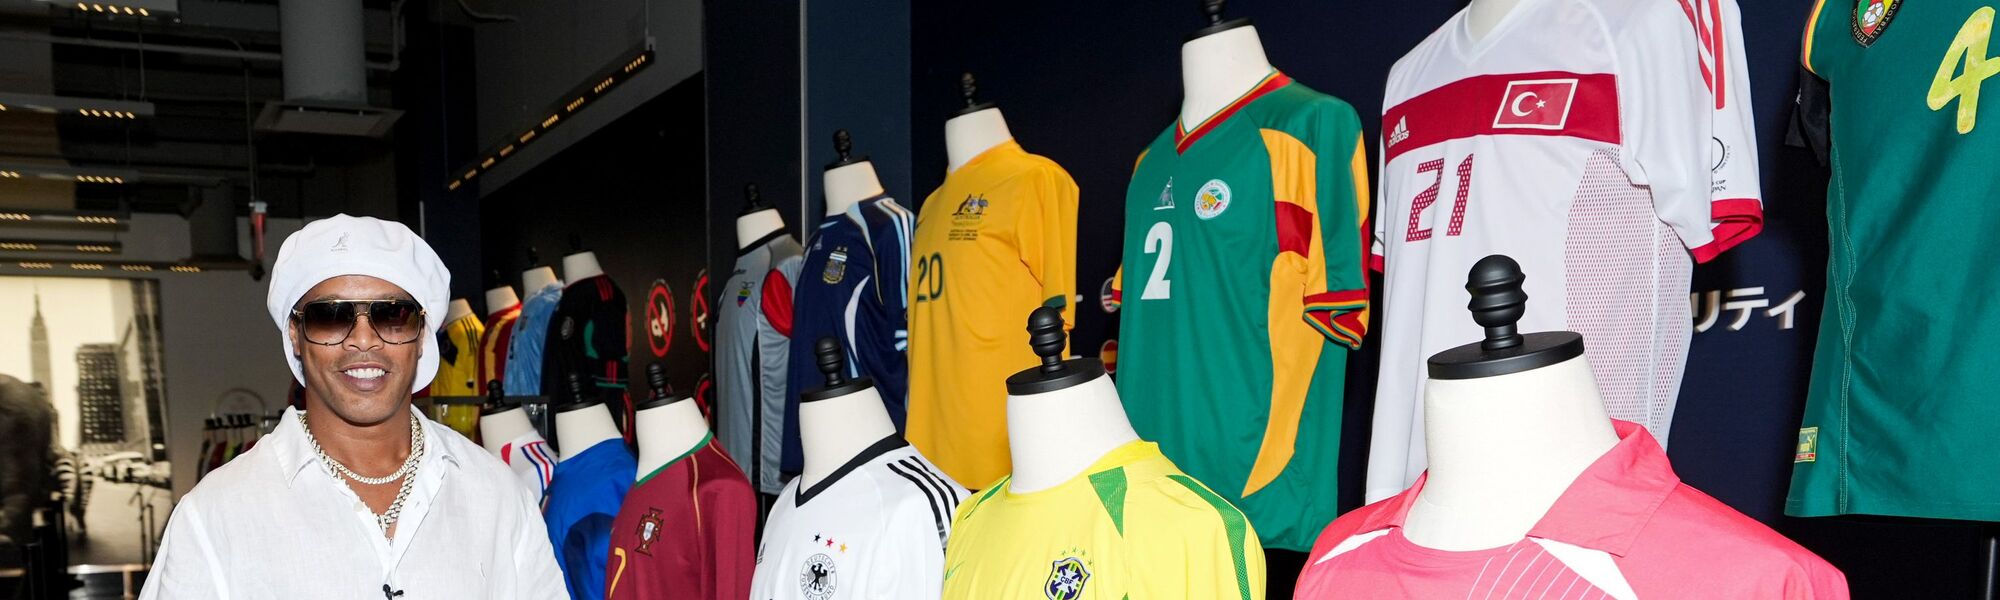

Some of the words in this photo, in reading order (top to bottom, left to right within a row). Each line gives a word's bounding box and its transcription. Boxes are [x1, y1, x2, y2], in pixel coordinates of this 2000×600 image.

[1926, 6, 2000, 134] 4
[1388, 130, 1409, 148] adidas
[1405, 153, 1474, 242] 21
[916, 252, 943, 302] 20
[1140, 221, 1173, 300] 2
[609, 547, 627, 599] 7
[1060, 576, 1074, 585] CBF
